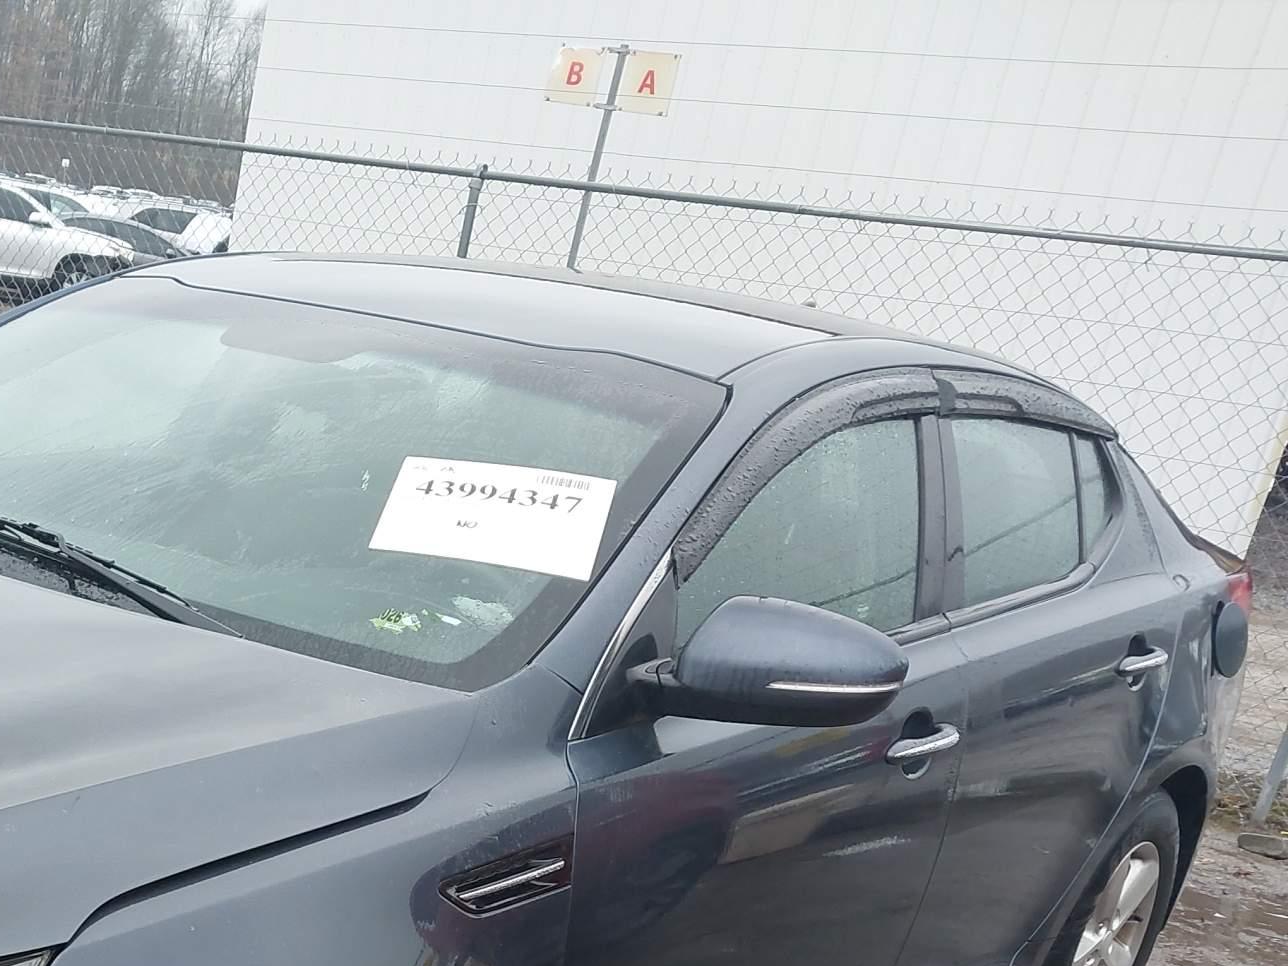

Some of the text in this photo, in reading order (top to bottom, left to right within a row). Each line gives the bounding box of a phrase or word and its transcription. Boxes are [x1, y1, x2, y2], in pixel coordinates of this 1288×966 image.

[566, 61, 585, 86] B
[637, 70, 655, 95] A
[415, 480, 583, 513] 43994347
